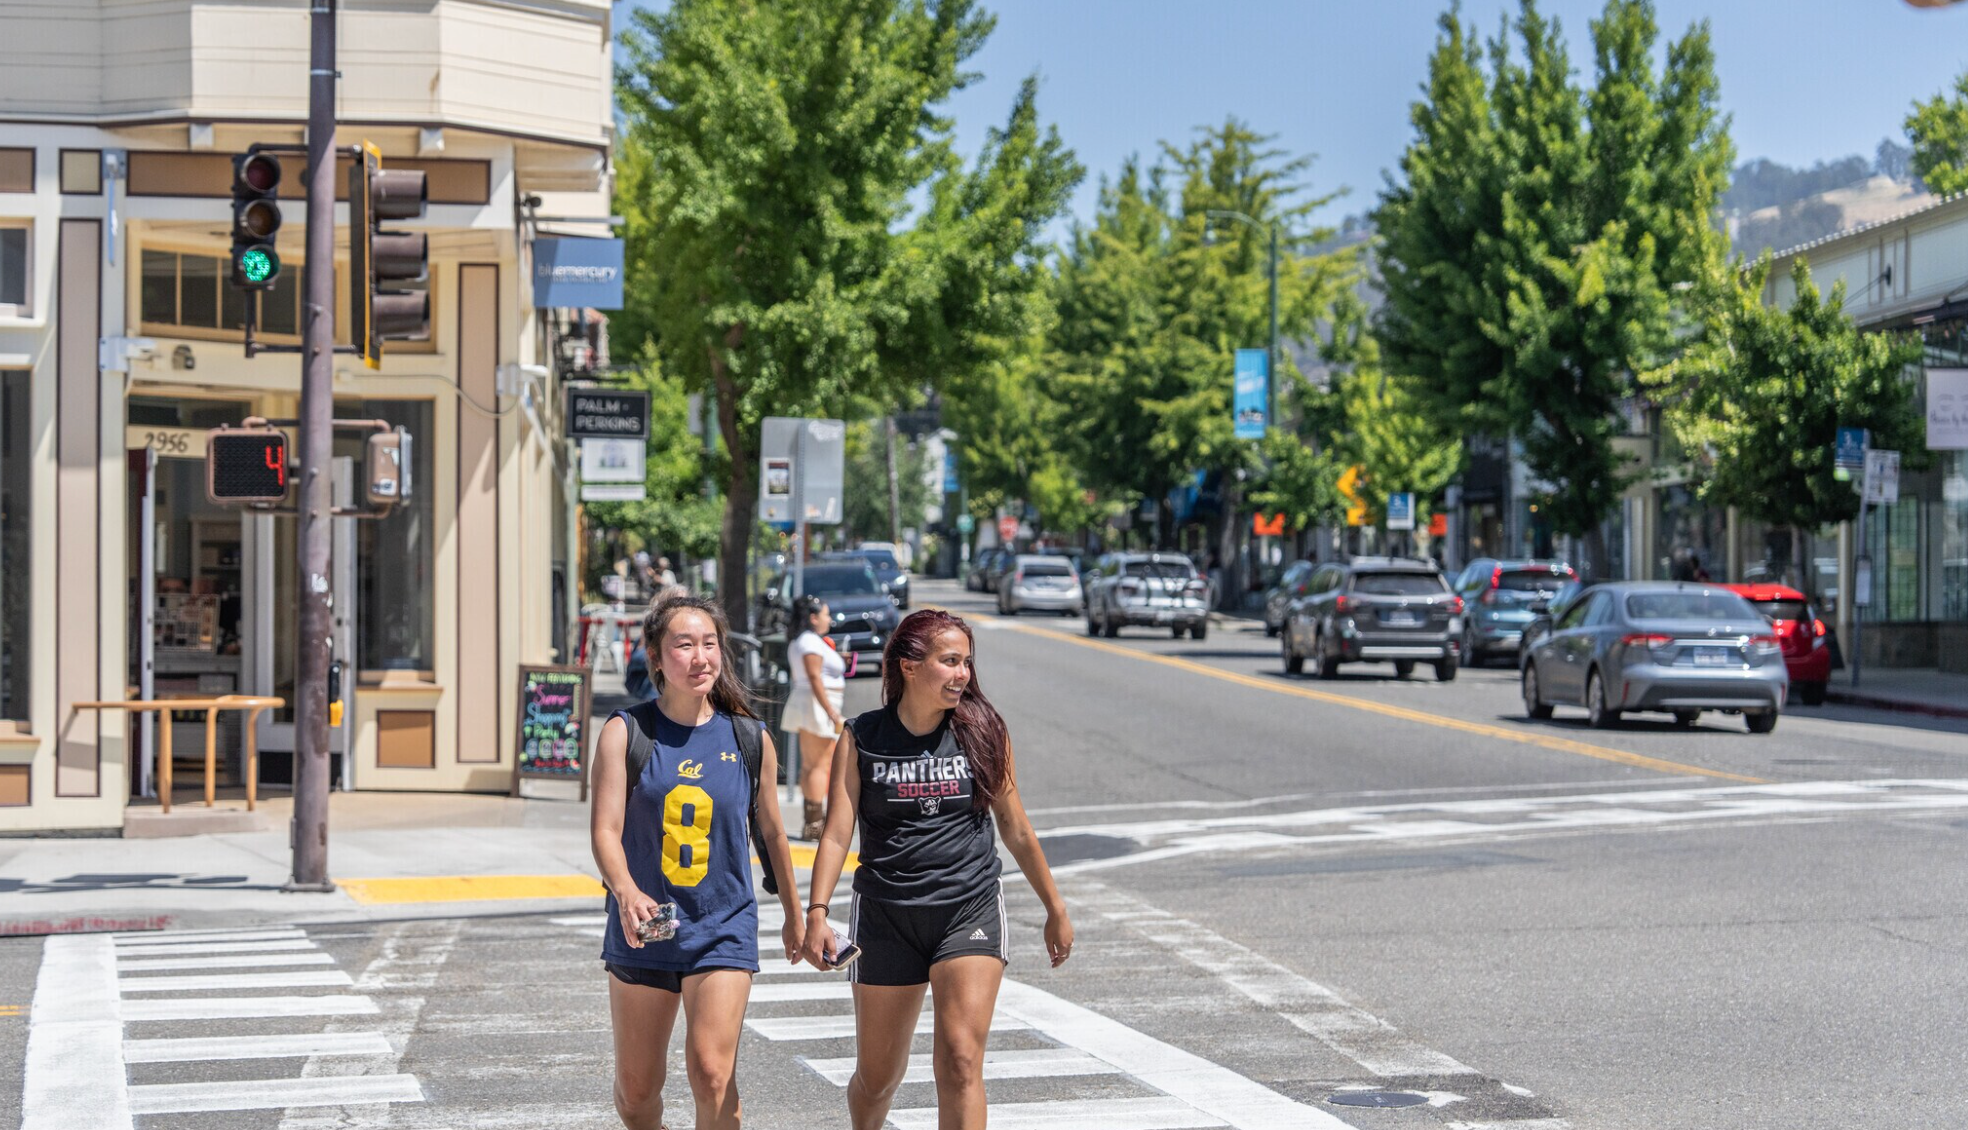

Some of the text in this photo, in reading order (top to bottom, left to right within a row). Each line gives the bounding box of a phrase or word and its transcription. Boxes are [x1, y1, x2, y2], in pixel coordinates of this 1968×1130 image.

[576, 398, 620, 414] PALM
[575, 415, 641, 432] PERKINS
[145, 431, 191, 453] 2956
[265, 445, 284, 487] 4
[677, 759, 704, 779] Cal
[897, 780, 960, 798] SOCCER
[661, 784, 714, 887] 8
